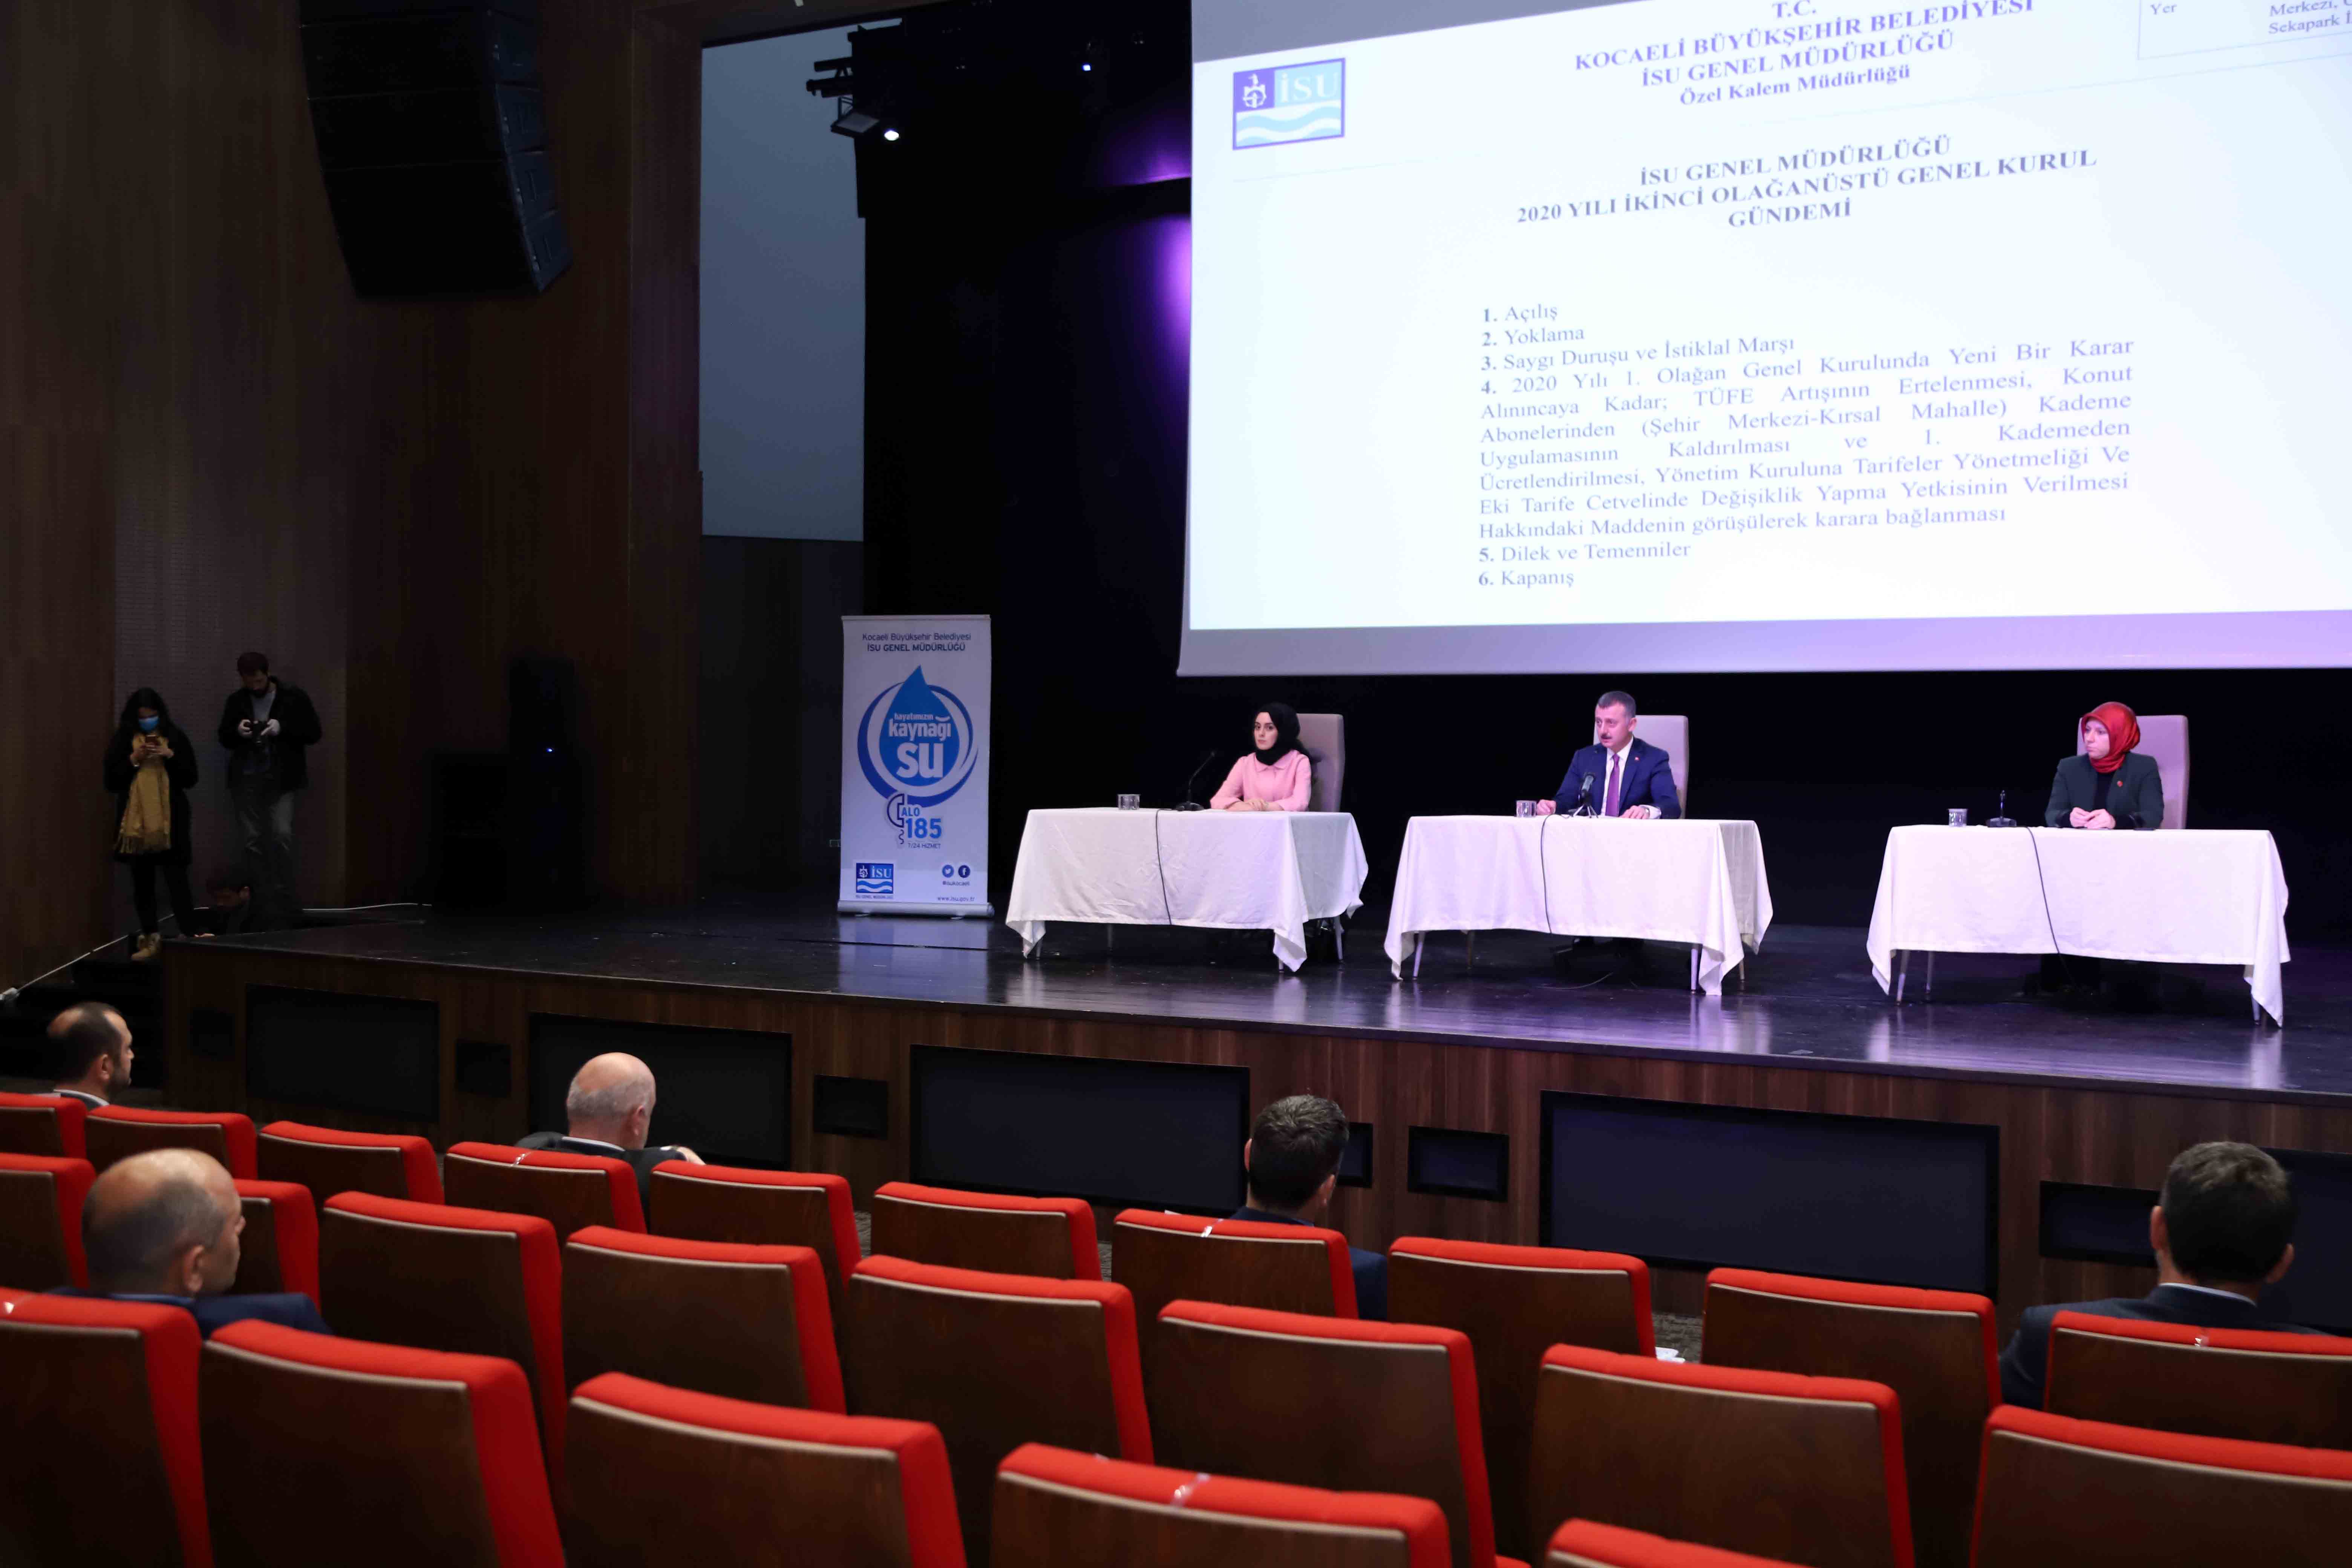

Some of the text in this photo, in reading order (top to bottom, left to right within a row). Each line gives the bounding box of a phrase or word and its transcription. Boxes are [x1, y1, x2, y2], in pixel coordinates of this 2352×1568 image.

[1772, 0, 1817, 19] T.C.
[2150, 3, 2178, 15] Yer
[2268, 14, 2341, 35] Sekapark
[1575, 37, 1685, 70] KOCAELİ
[1694, 16, 1863, 55] BÜYÜKŞEHİR
[1642, 28, 1954, 87] İSU GENEL MÜDÜRLÜĞÜ
[1679, 64, 1911, 106] Özel Kalem Müdürlüğü
[1640, 133, 1950, 186] İSU GENEL MÜDÜRLÜĞÜ
[1517, 149, 2097, 224] 2020 YILI İKİNCİ OLAĞANÜSTÜ GENEL KURUL
[1727, 196, 1851, 228] GÜNDEMİ
[1483, 303, 1558, 323] 1. Açılış
[1481, 327, 1585, 347] 2. Yoklama
[1480, 340, 2135, 395] 4. 2020 Yılı 1. Olağan Genel Kurulunda Yeni Bir Karar
[1481, 337, 1795, 372] 3. Saygı Duruşu ve İstiklal Marşı
[1481, 366, 2133, 420] Alınıncaya Kadar; TÜFE Artışının Ertelenmesi, Konut
[1481, 393, 2132, 443] Abonelerinden (Şehir Merkezi-Kırsal Mahalle) Kademe
[1480, 418, 2130, 470] Uygulamasının Kaldırılması ve 1. Kademeden
[1480, 446, 2130, 491] Ücretlendirilmesi, Yönetim Kuruluna Tarifeler Yönetmeliği Ve
[1480, 472, 2128, 514] Eki Tarife Cetvelinde Değişiklik Yapma Yetkisinin Verilmesi
[1480, 507, 2006, 539] Hakkındaki Maddenin görüşülerek karara bağlanması
[1478, 541, 1691, 562] 5. Dilek ve Temenniler
[1478, 570, 1574, 589] 6. Kapanış
[862, 632, 888, 641] Kocaeli
[934, 632, 971, 642] Belediyesi
[867, 642, 881, 652] İSU
[912, 642, 965, 651] MÜDÜRLÜĞÜ
[889, 716, 951, 742] kaynağı
[901, 807, 920, 817] ALO
[905, 818, 942, 839] 185
